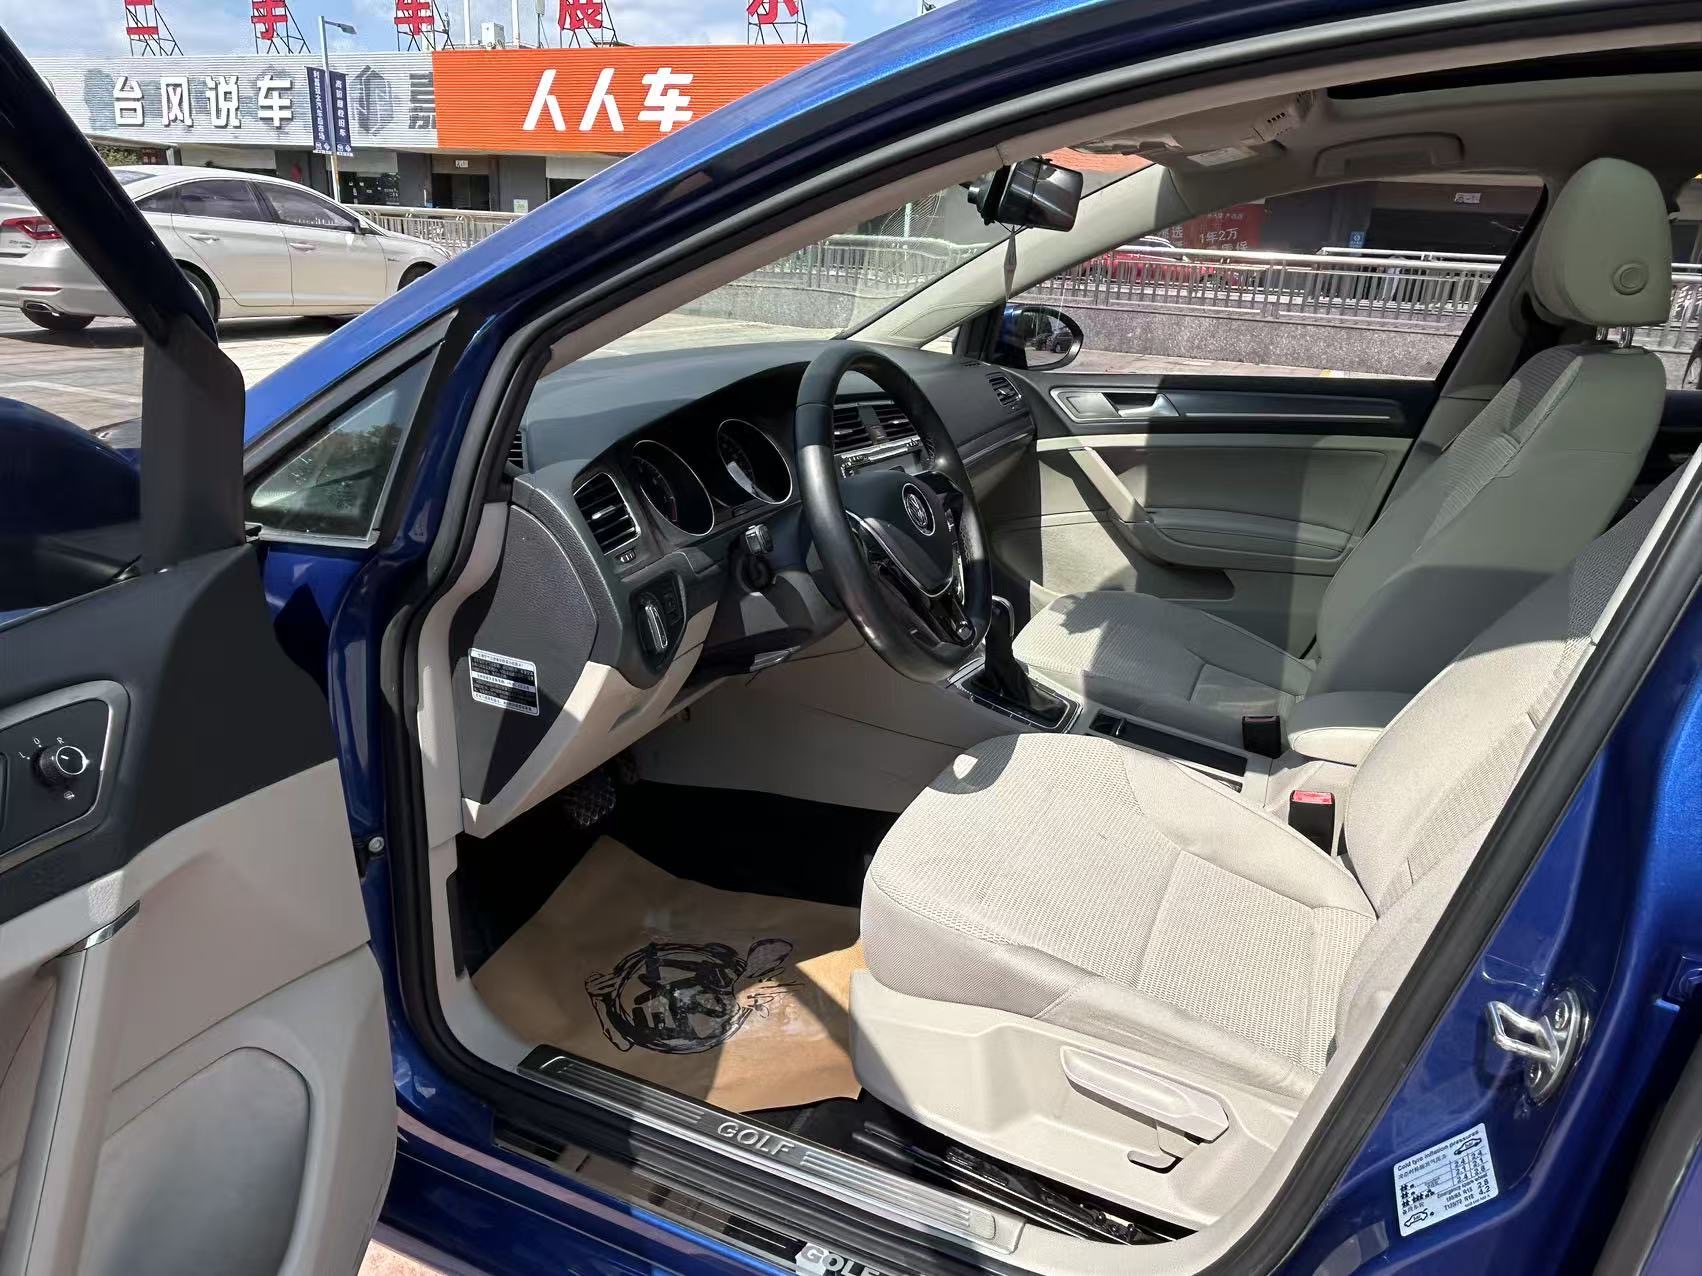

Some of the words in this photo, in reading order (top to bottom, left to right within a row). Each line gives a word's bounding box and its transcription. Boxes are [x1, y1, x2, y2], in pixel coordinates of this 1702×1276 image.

[113, 75, 293, 127] 台风说车
[522, 67, 694, 132] 人人车
[717, 1121, 795, 1155] GOLF
[1398, 1160, 1413, 1171] Cold
[1478, 1186, 1490, 1195] 4.2
